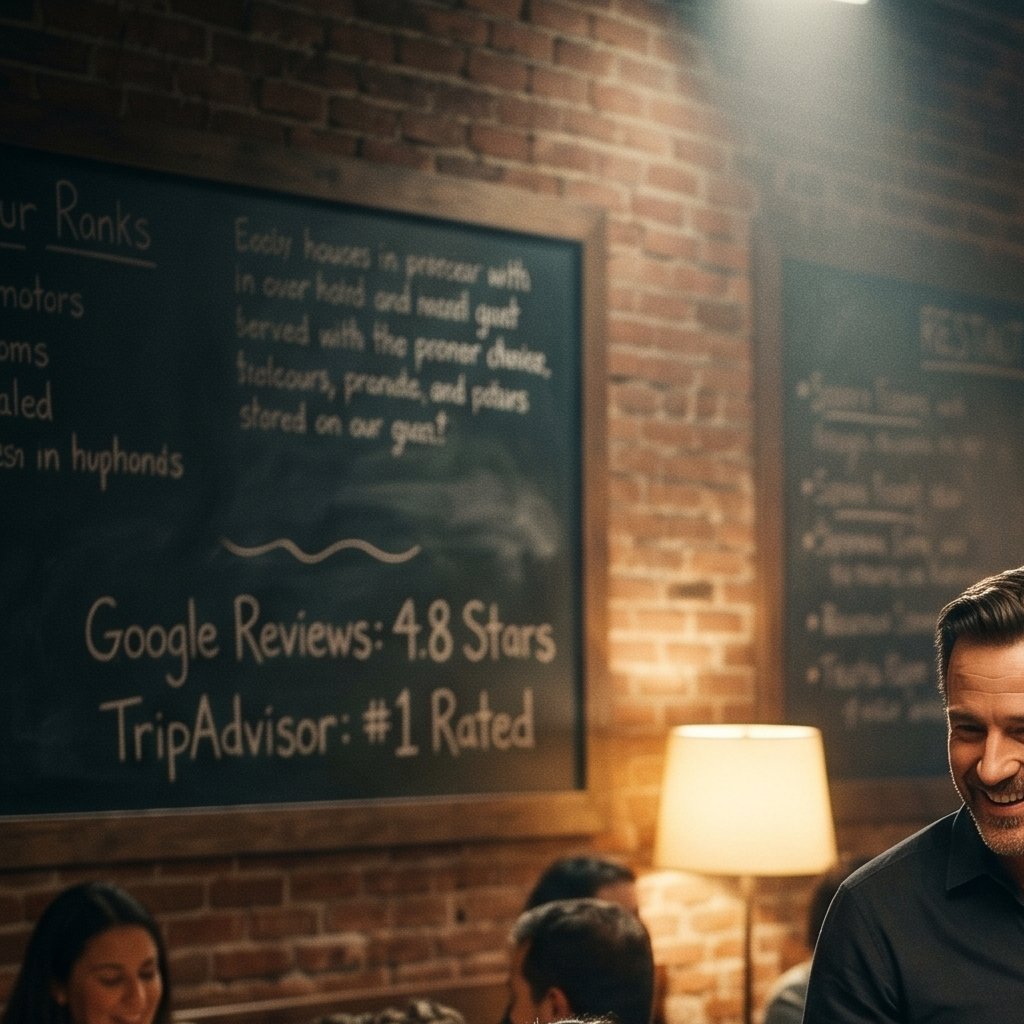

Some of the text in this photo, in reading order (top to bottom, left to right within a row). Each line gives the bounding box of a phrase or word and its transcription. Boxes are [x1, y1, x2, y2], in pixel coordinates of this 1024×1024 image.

[55, 178, 152, 251] Ranks
[430, 373, 467, 405] and
[315, 414, 342, 437] on
[349, 417, 383, 439] our
[85, 594, 556, 688] Google Reviews: 4.8 Stars
[100, 687, 535, 783] TripAdvisor: #1 Rated
